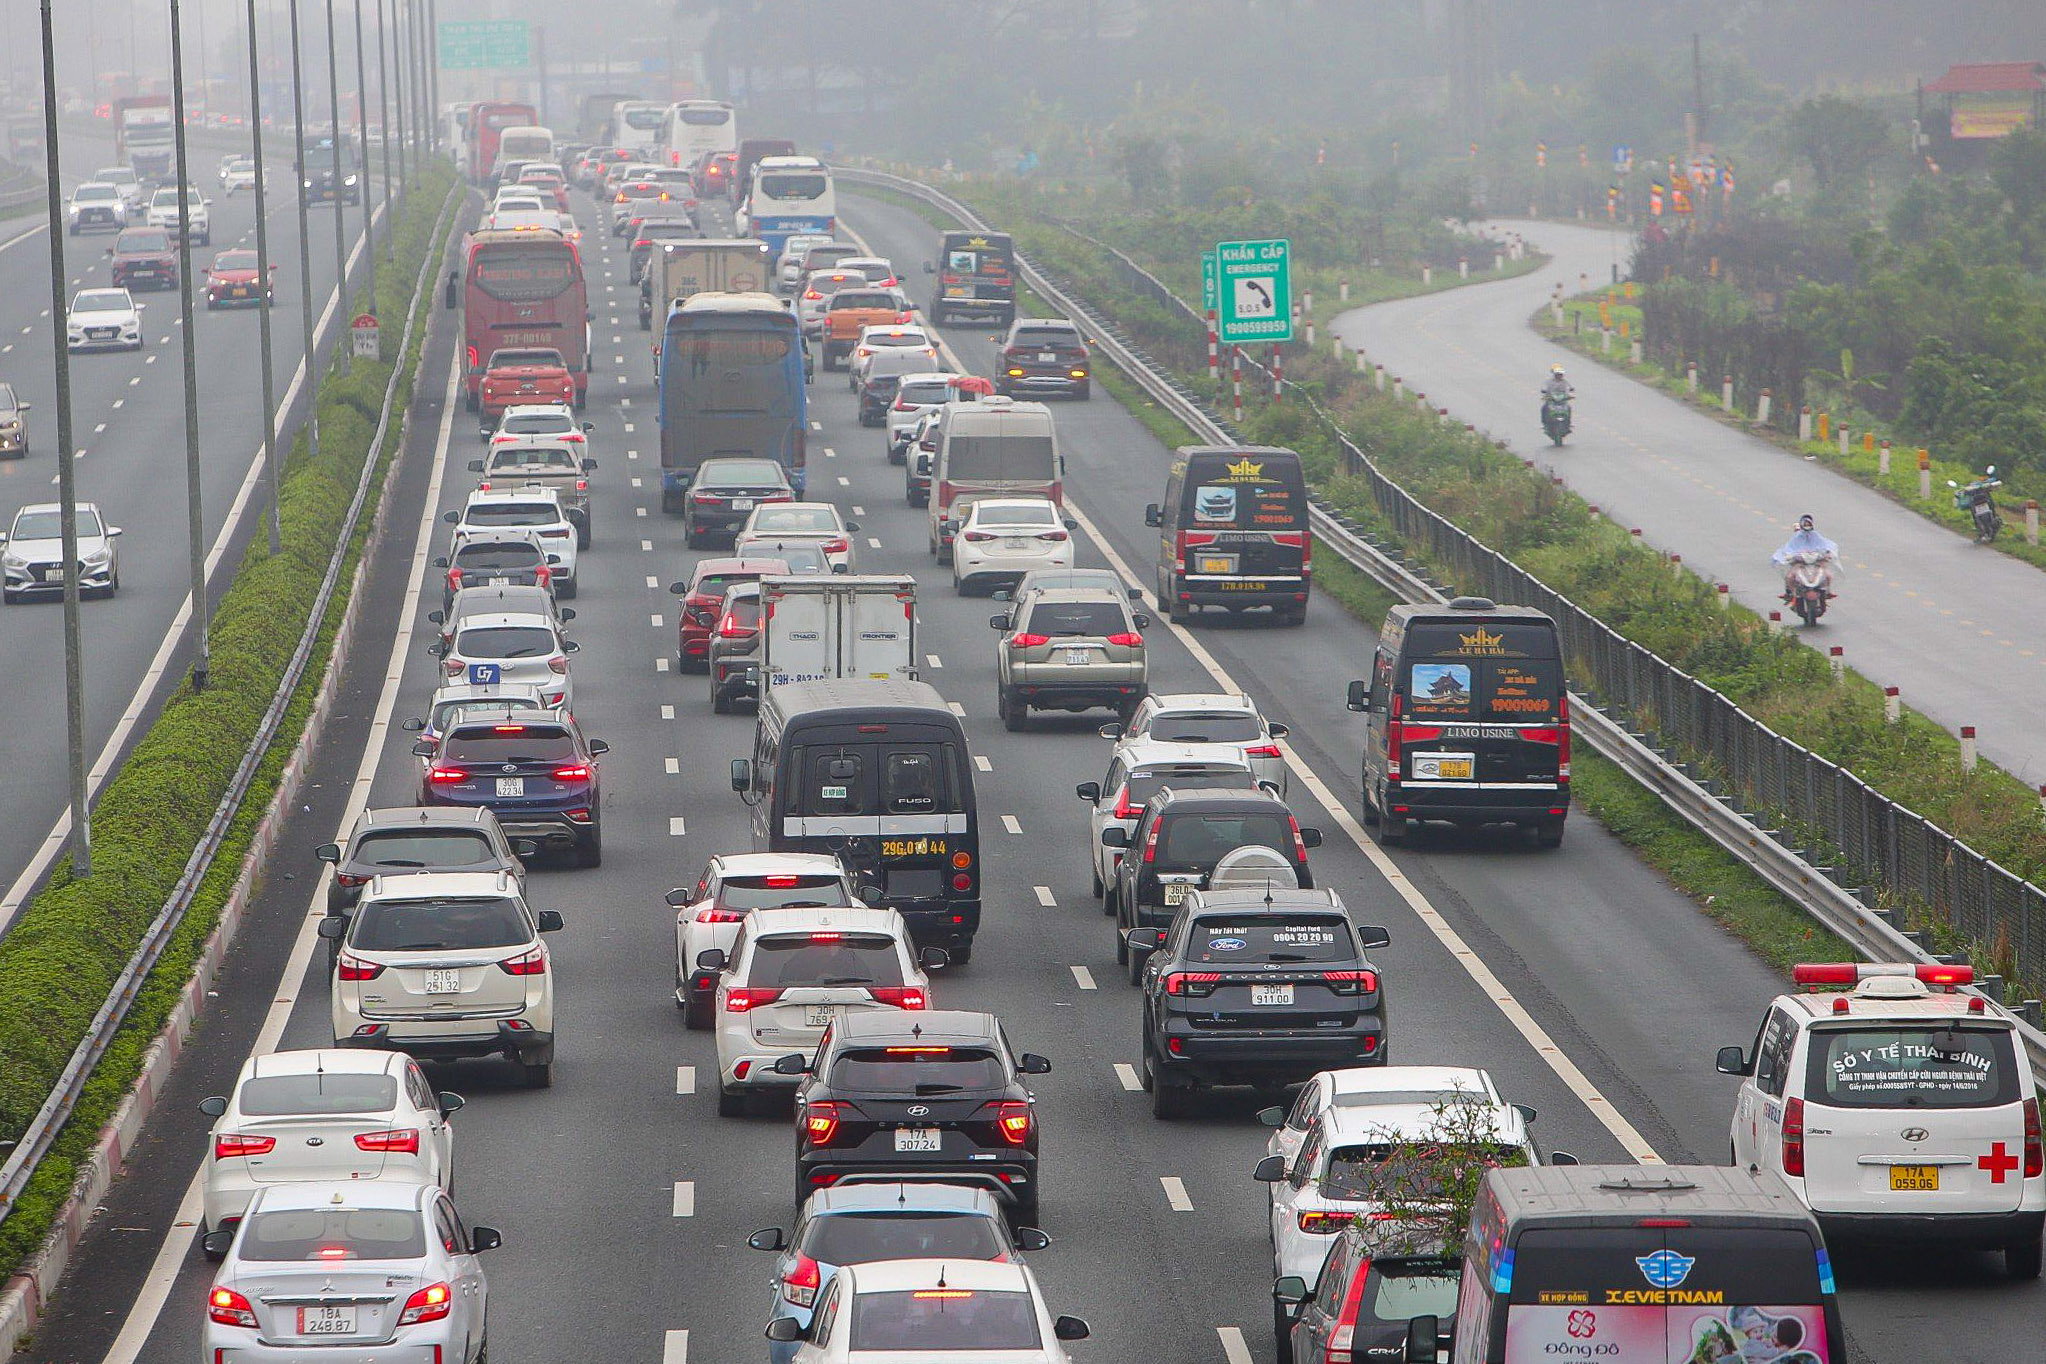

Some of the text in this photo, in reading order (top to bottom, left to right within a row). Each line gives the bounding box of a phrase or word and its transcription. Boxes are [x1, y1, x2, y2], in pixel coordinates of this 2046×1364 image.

[433, 971, 451, 980] 51G
[1264, 985, 1282, 994] 30H
[1257, 995, 1289, 1003] 911.00
[817, 1006, 834, 1014] 30H
[1860, 1050, 1872, 1062] Y
[1877, 1041, 1900, 1059] TẾ
[909, 1130, 928, 1139] 17A
[900, 1140, 936, 1150] 307.24
[1905, 1168, 1924, 1177] 17A
[1895, 1179, 1933, 1188] 059.06
[321, 1308, 341, 1319] 18A
[310, 1320, 350, 1332] 248.87
